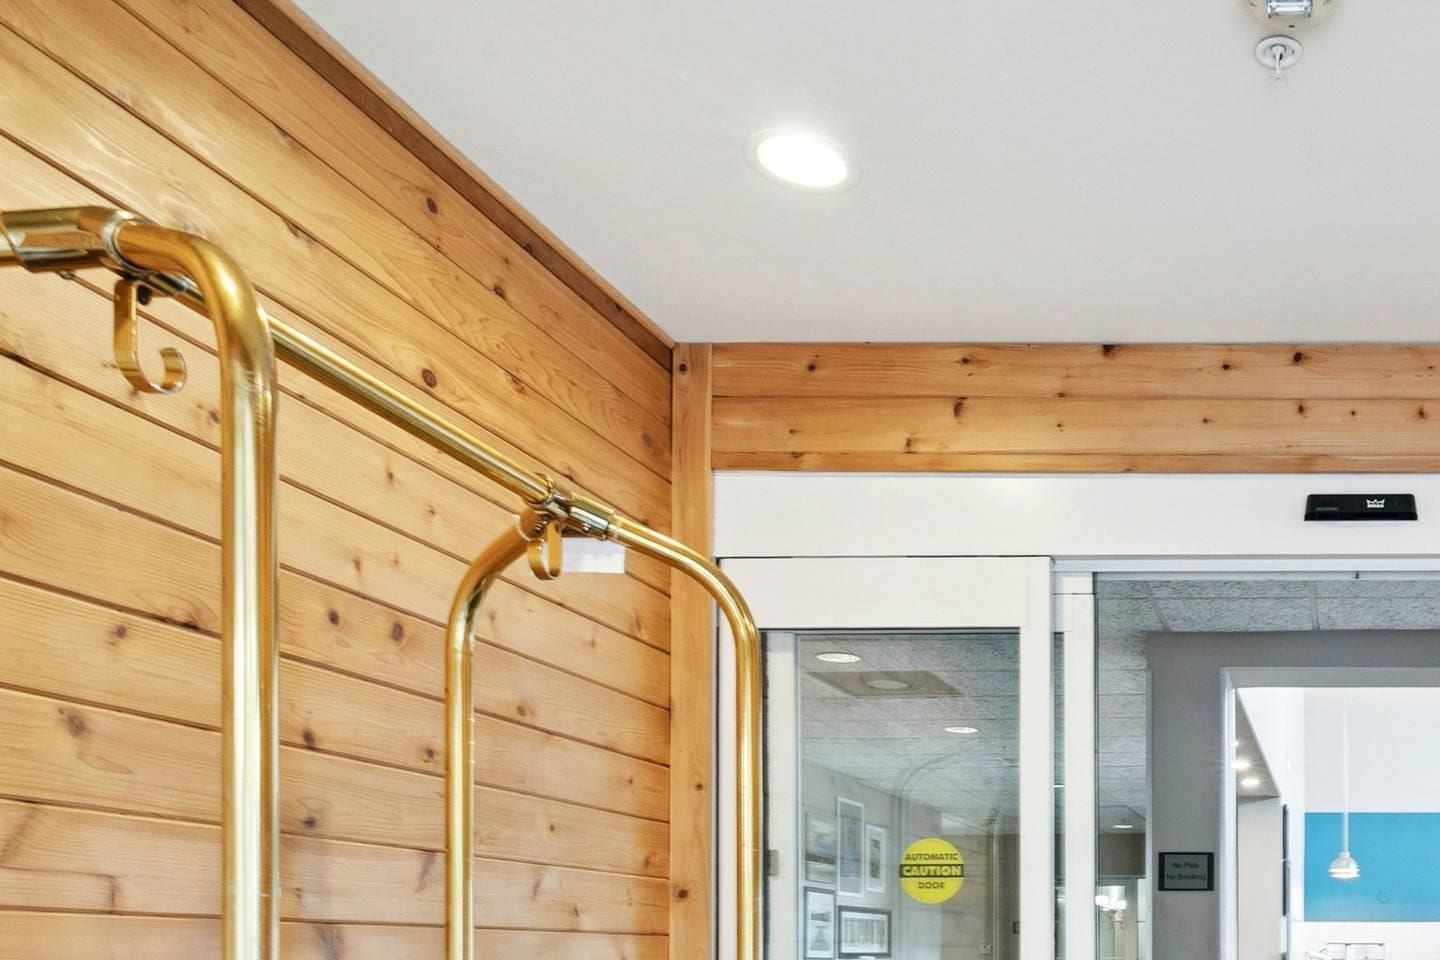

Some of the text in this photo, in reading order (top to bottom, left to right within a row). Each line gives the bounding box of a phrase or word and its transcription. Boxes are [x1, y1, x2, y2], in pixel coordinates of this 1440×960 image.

[905, 852, 959, 861] AUTOMATIC
[903, 865, 962, 876] CAUTION
[1177, 873, 1207, 882] Smoking
[917, 881, 946, 889] DOOR
